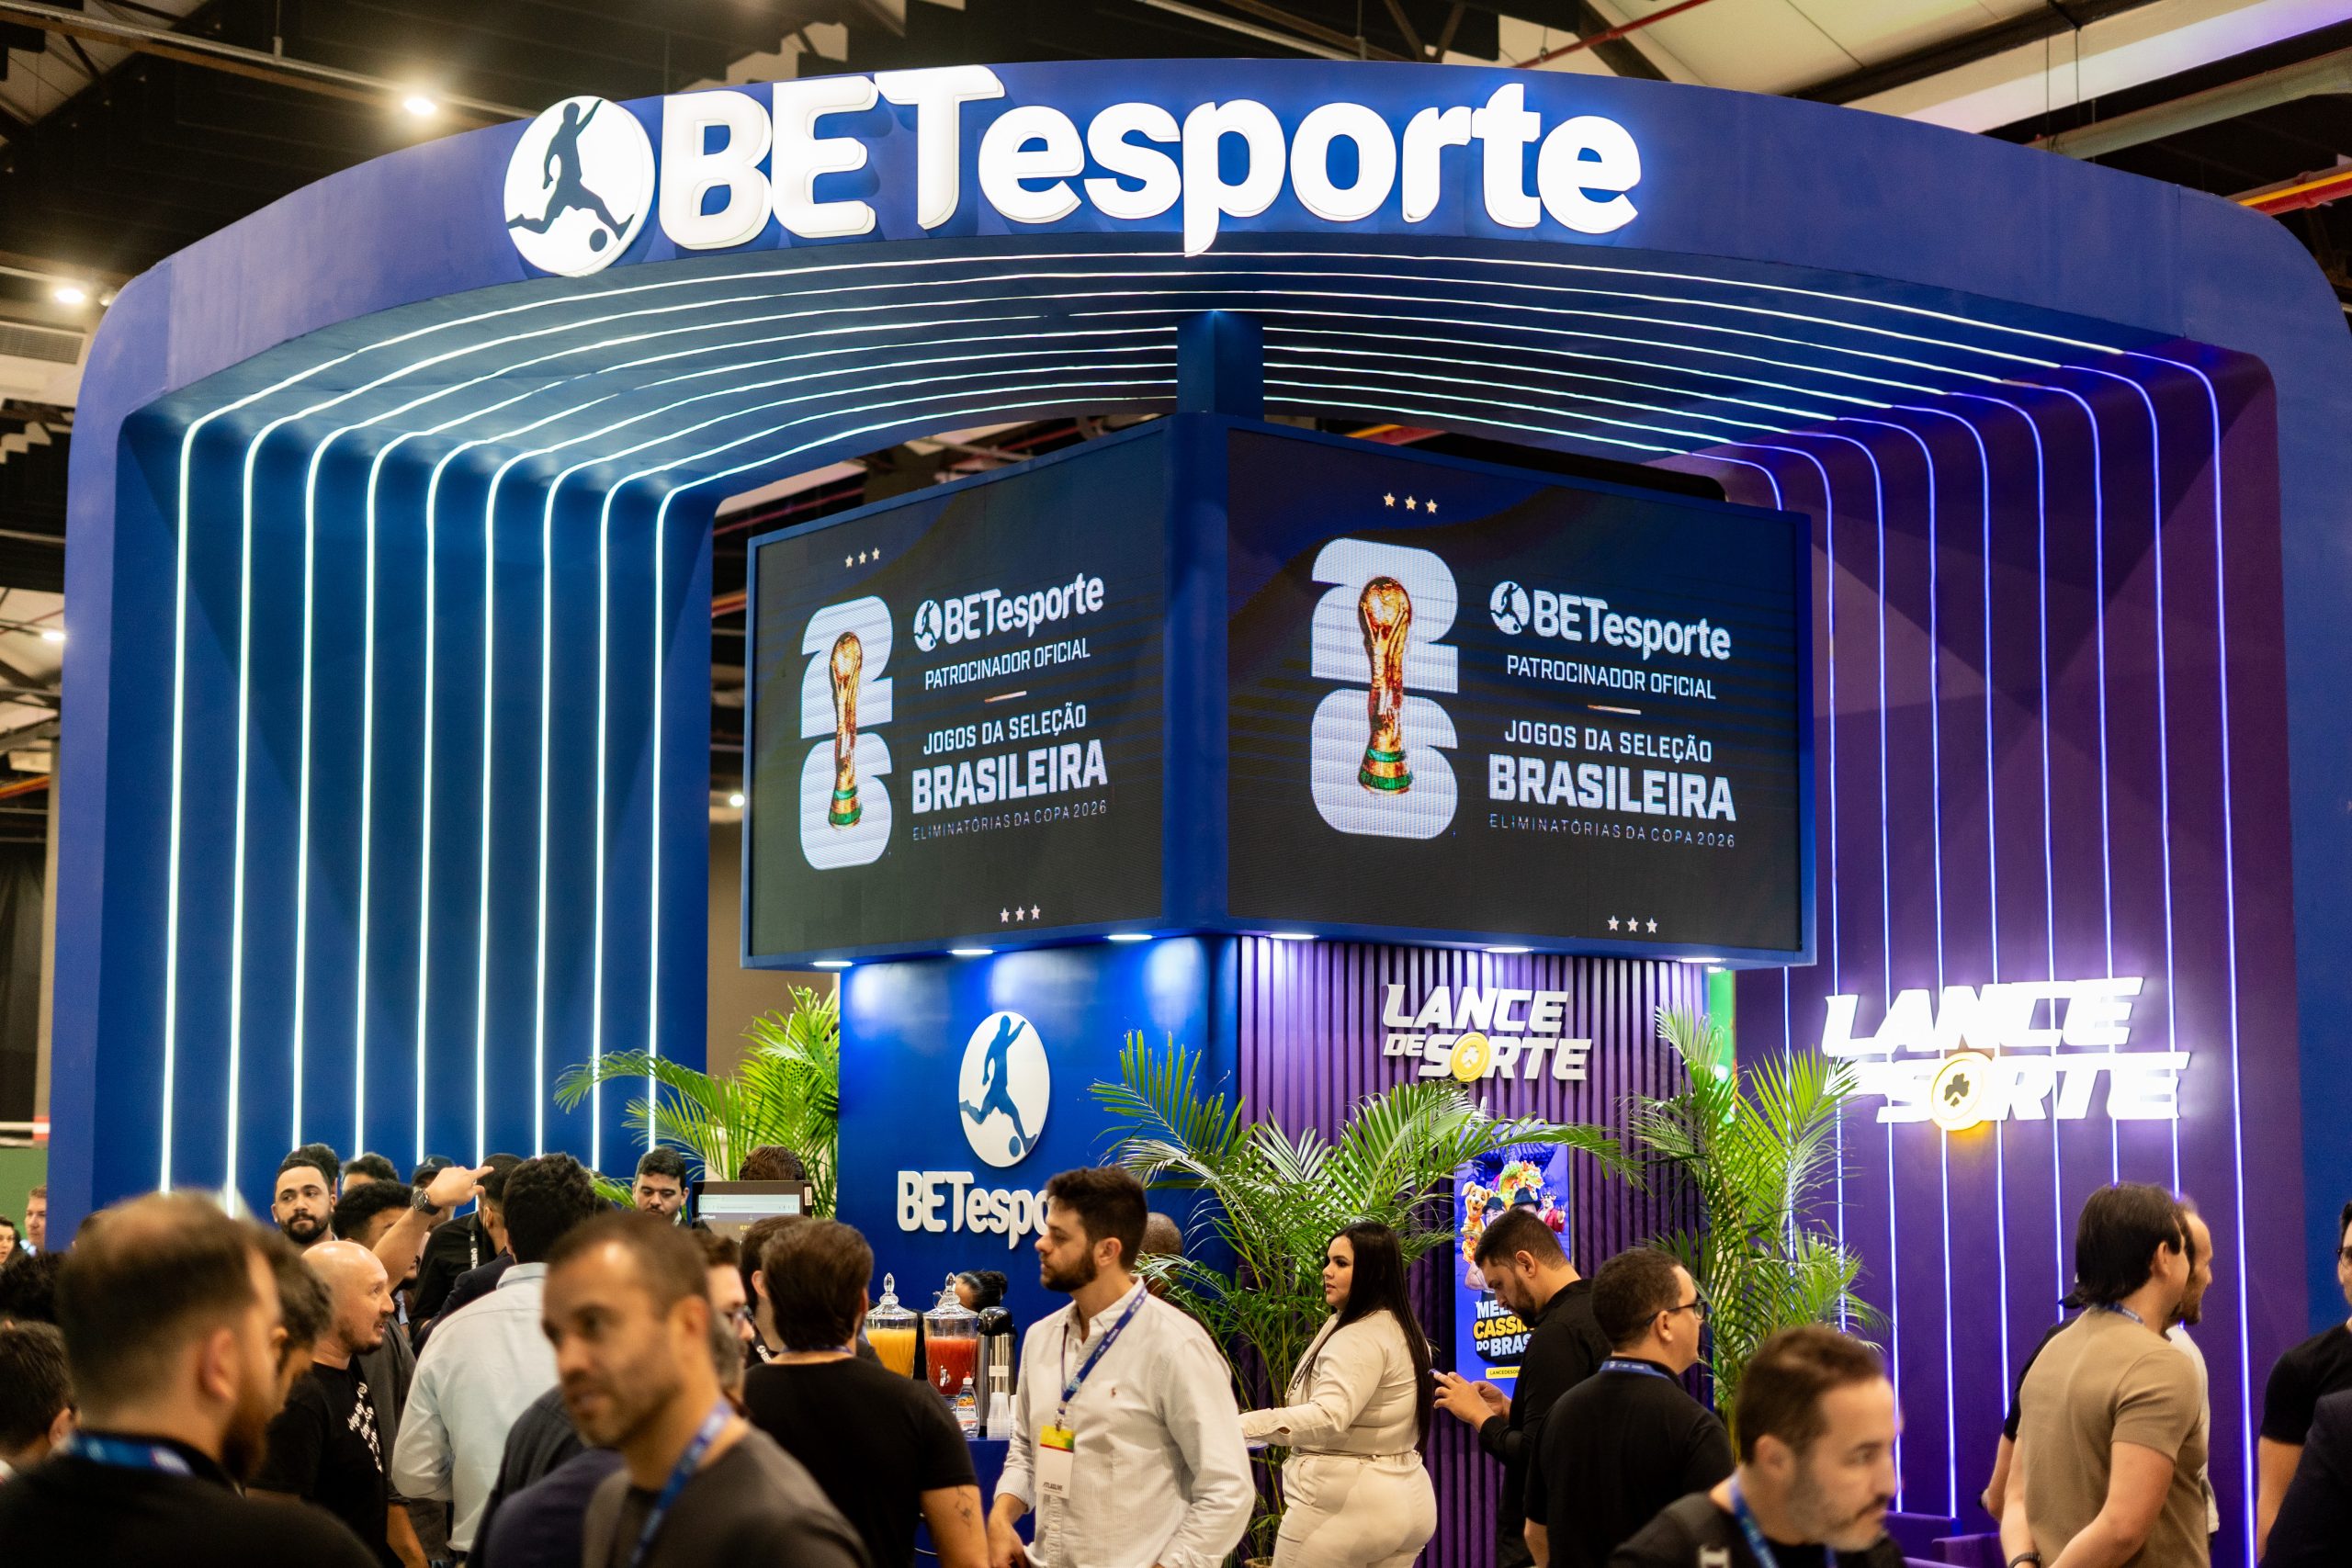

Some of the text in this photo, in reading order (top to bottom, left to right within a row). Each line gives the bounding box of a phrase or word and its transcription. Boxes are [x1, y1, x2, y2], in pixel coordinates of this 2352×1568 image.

[659, 64, 1642, 257] BETesporte
[944, 572, 1104, 644] BETesporte
[1533, 589, 1732, 660] BETesporte
[925, 637, 1091, 690] PATROCINADOR OFICIAL
[1507, 654, 1717, 699] PATROCINADOR OFICIAL
[923, 702, 1086, 755] JOGOS DA SELEÇÃO
[1504, 719, 1713, 763] JOGOS DA SELEÇÃO
[912, 739, 1108, 814] BRASILEIRA
[1488, 753, 1736, 822] BRASILEIRA
[913, 799, 1107, 840] ELIMINATÓRIAS DA COPA 2026
[1489, 813, 1736, 847] ELIMINATÓRIAS DA COPA 2026
[1382, 984, 1568, 1033] LANCE
[1822, 977, 2143, 1058] LANCE
[1383, 1032, 1591, 1082] DE SORTE
[897, 1170, 1049, 1249] BETespo
[1473, 1315, 1528, 1339] CASSI
[1476, 1300, 1513, 1319] MEL
[1476, 1334, 1532, 1357] DO BRAS
